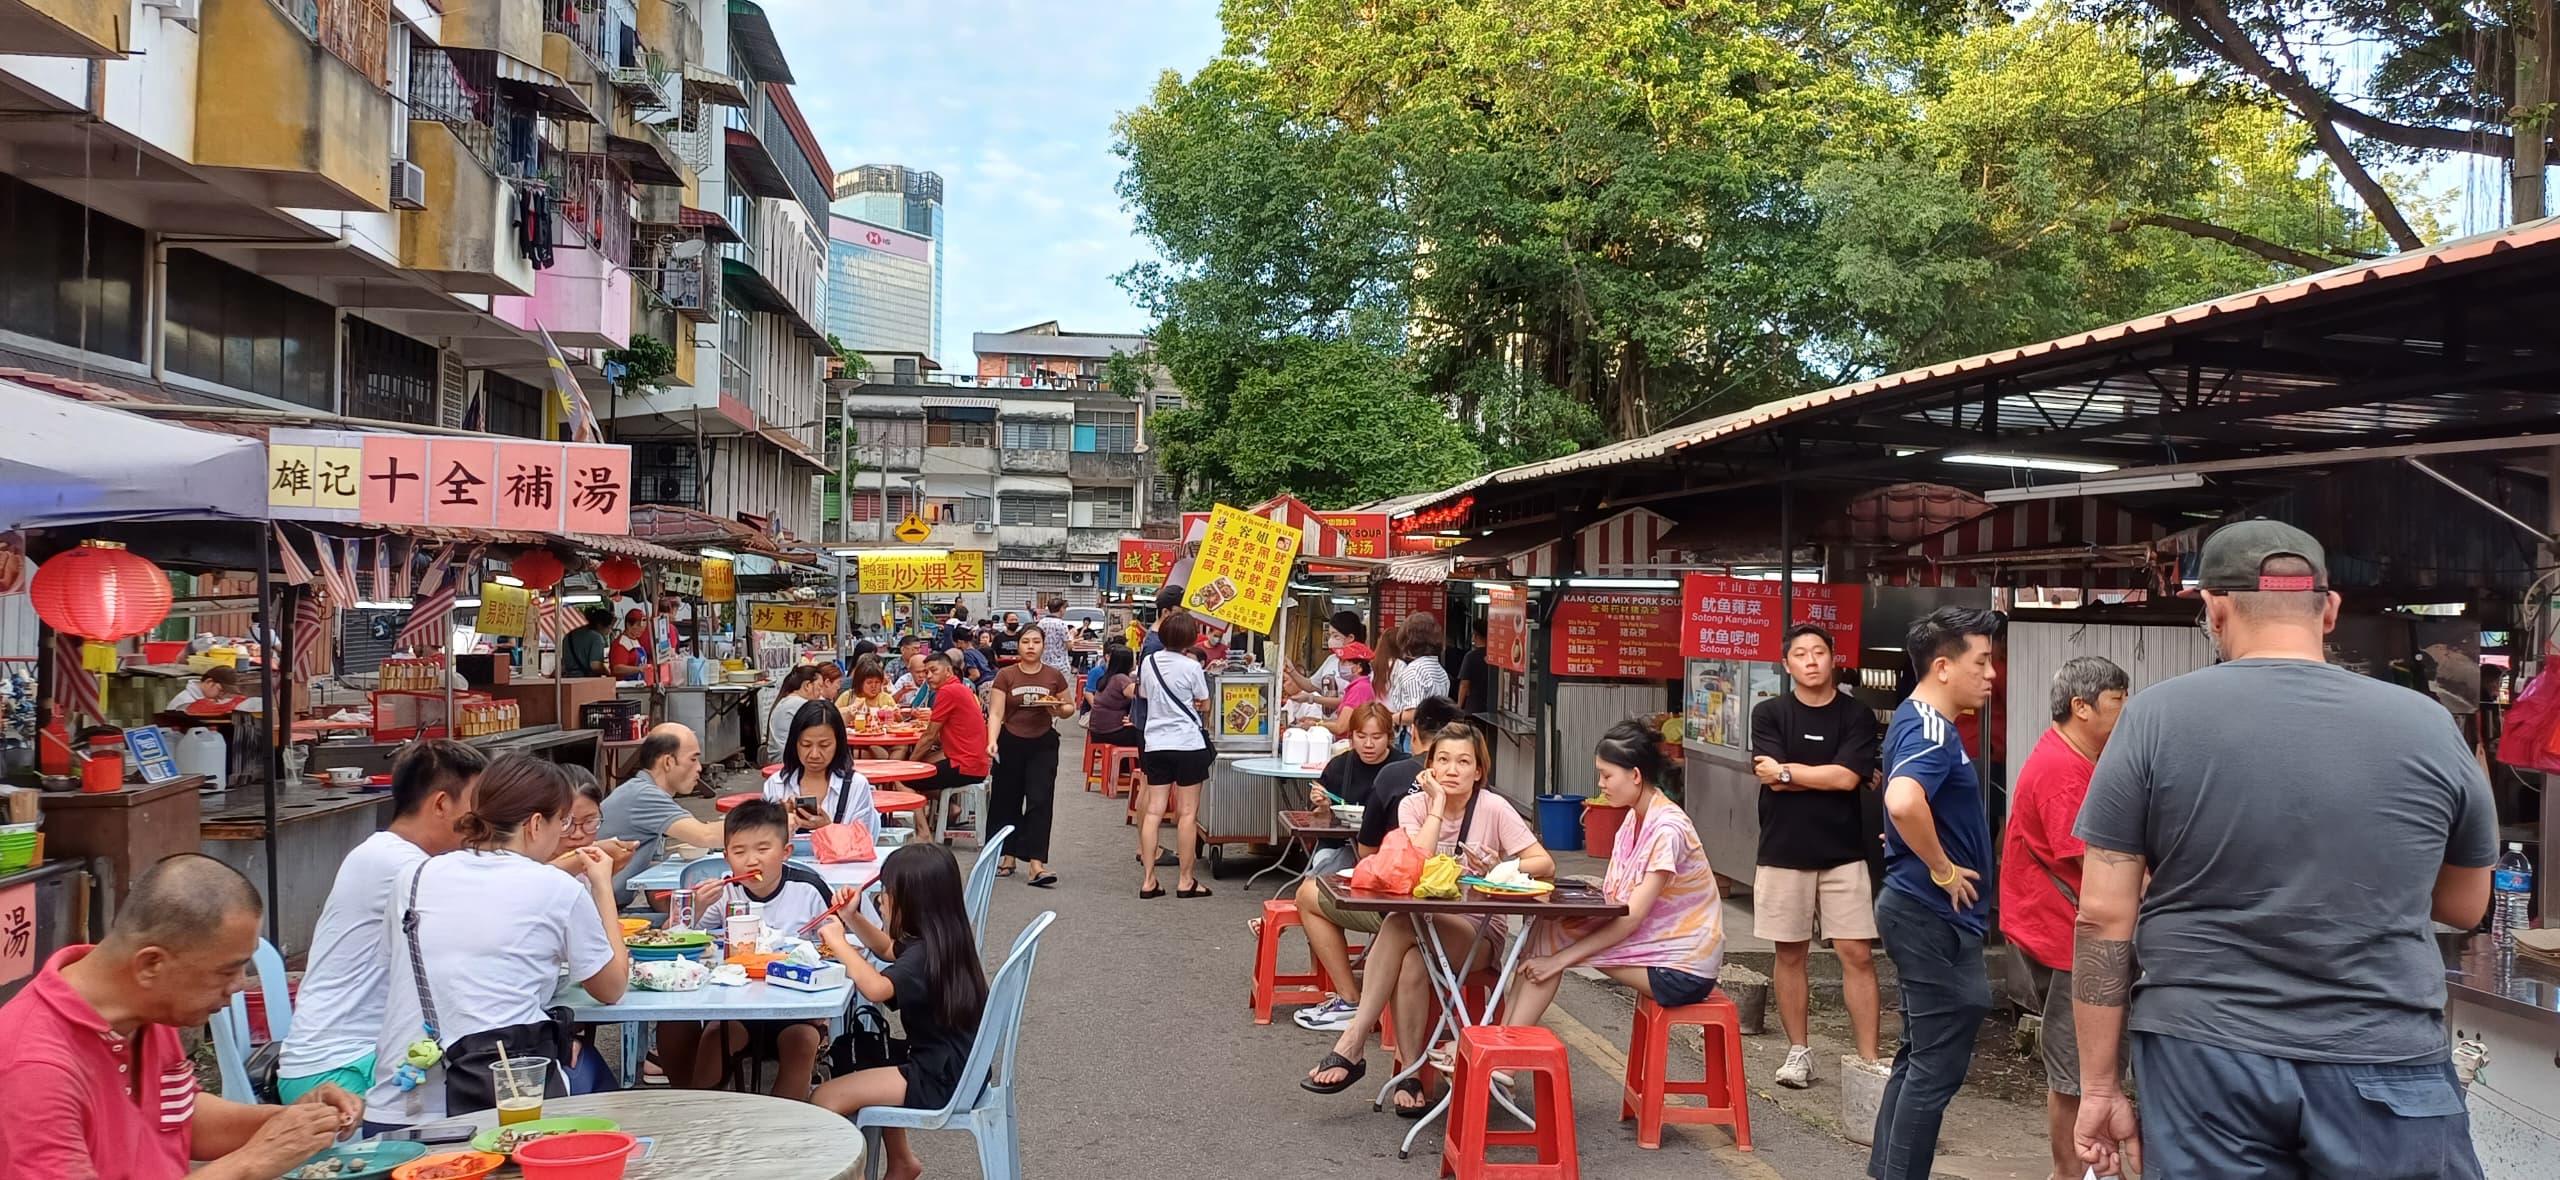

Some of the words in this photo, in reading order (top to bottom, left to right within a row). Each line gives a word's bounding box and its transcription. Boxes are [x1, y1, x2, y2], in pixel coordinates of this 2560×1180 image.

[272, 459, 357, 497] 雄记
[368, 456, 622, 515] 十全補湯
[1355, 529, 1382, 538] SOUP
[891, 561, 978, 591] 炒粿条
[863, 578, 890, 592] 鸡蛋
[1563, 594, 1586, 603] KAM
[1588, 595, 1609, 604] GOR
[1612, 596, 1630, 605] MIX
[1632, 597, 1659, 606] PORK
[1660, 598, 1683, 607] SOU
[1691, 612, 1725, 625] Sotong
[1725, 613, 1770, 627] Kangkung
[1828, 621, 1853, 631] Salad
[1700, 643, 1732, 656] Sotong
[1733, 645, 1758, 657] Rojak
[1407, 780, 1421, 794] RK
[3, 906, 31, 959] 湯
